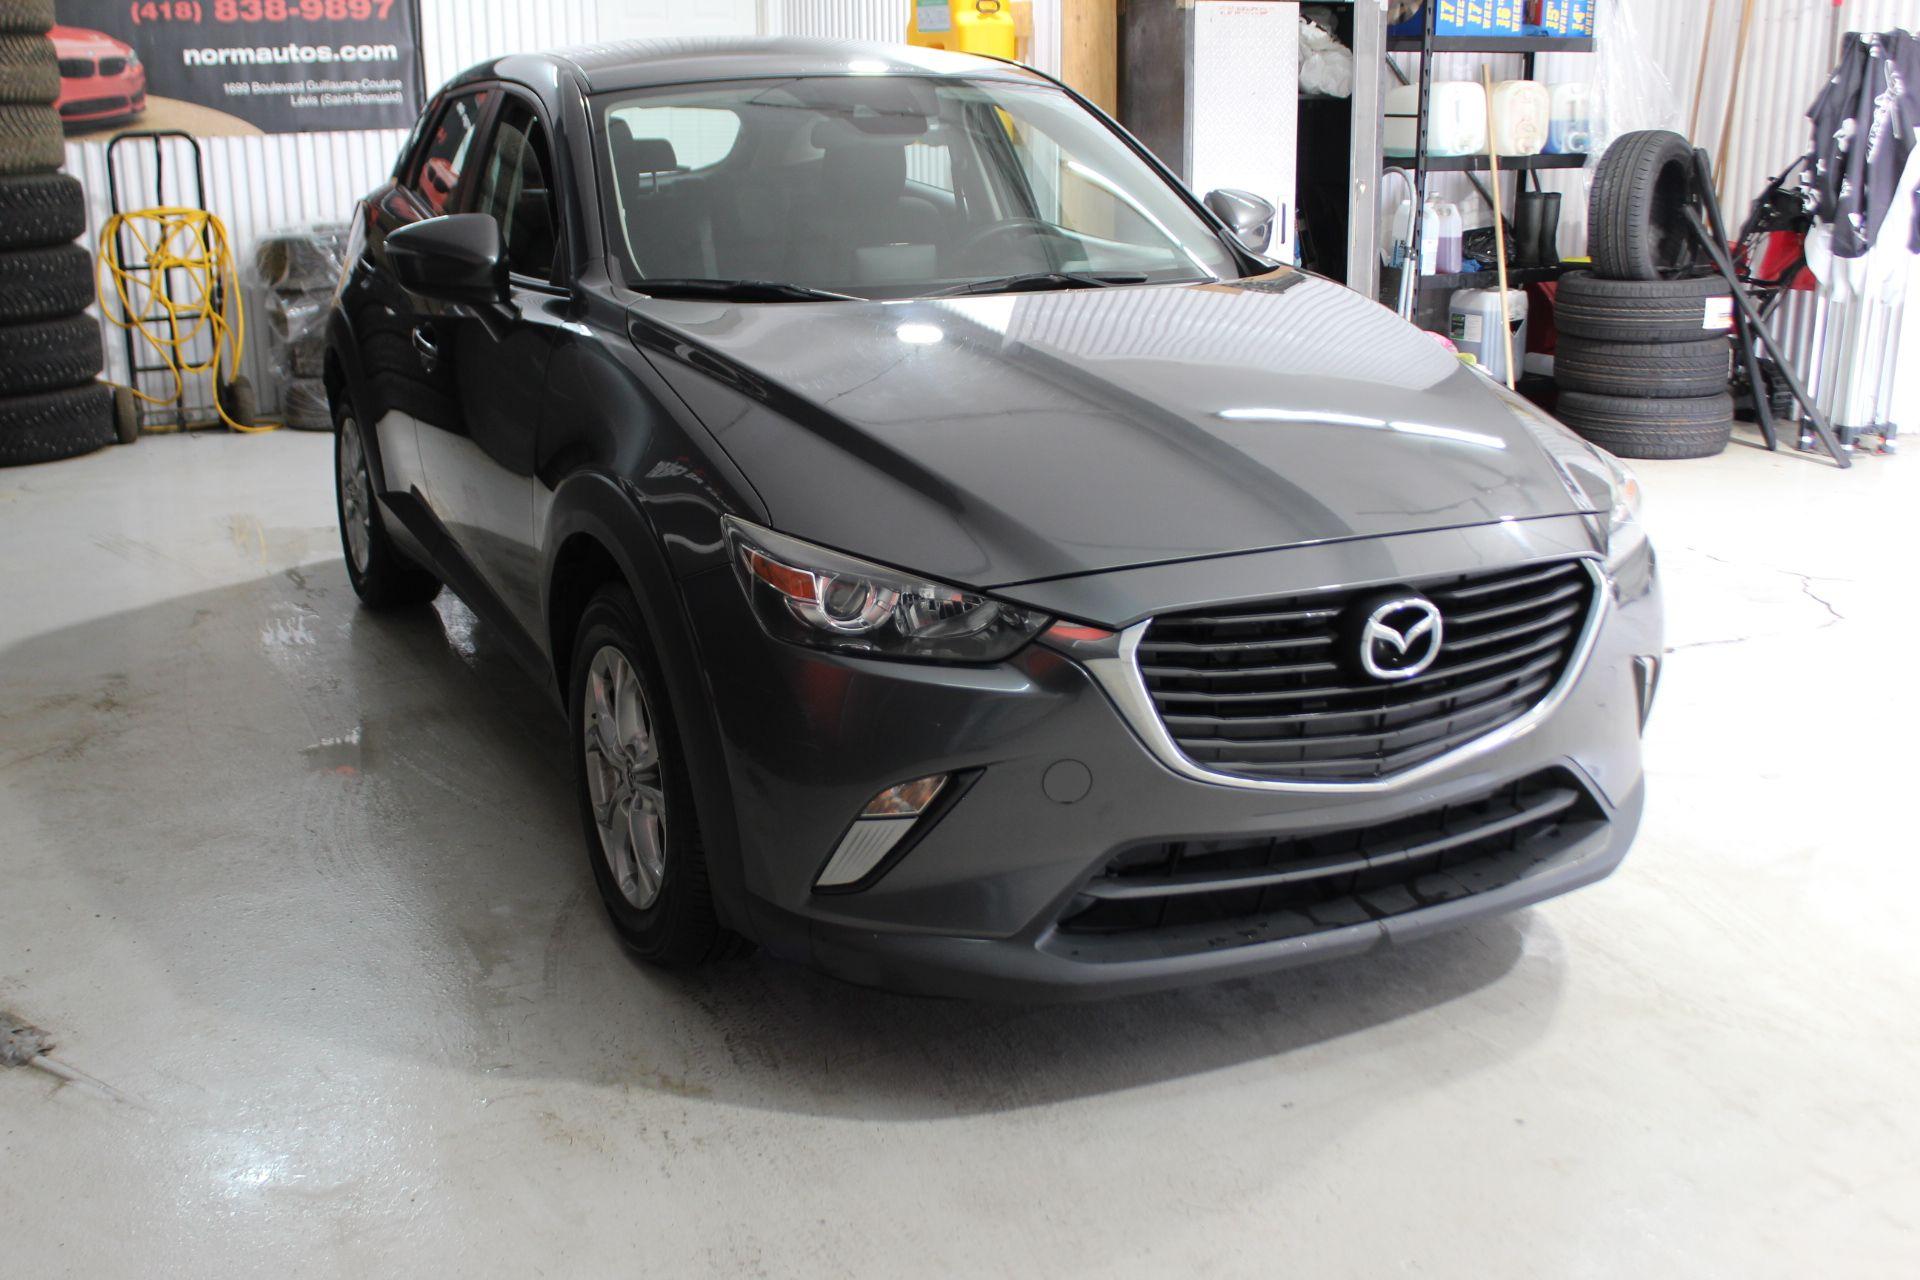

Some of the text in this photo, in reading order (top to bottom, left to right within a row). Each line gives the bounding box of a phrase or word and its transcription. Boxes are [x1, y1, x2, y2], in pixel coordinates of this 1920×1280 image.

[131, 0, 394, 25] (418) 838-9897
[183, 43, 398, 66] normautos.com
[251, 80, 305, 95] Boulevard
[306, 78, 402, 92] Guillaume-Couture
[321, 91, 403, 107] (Saint-Romuald)
